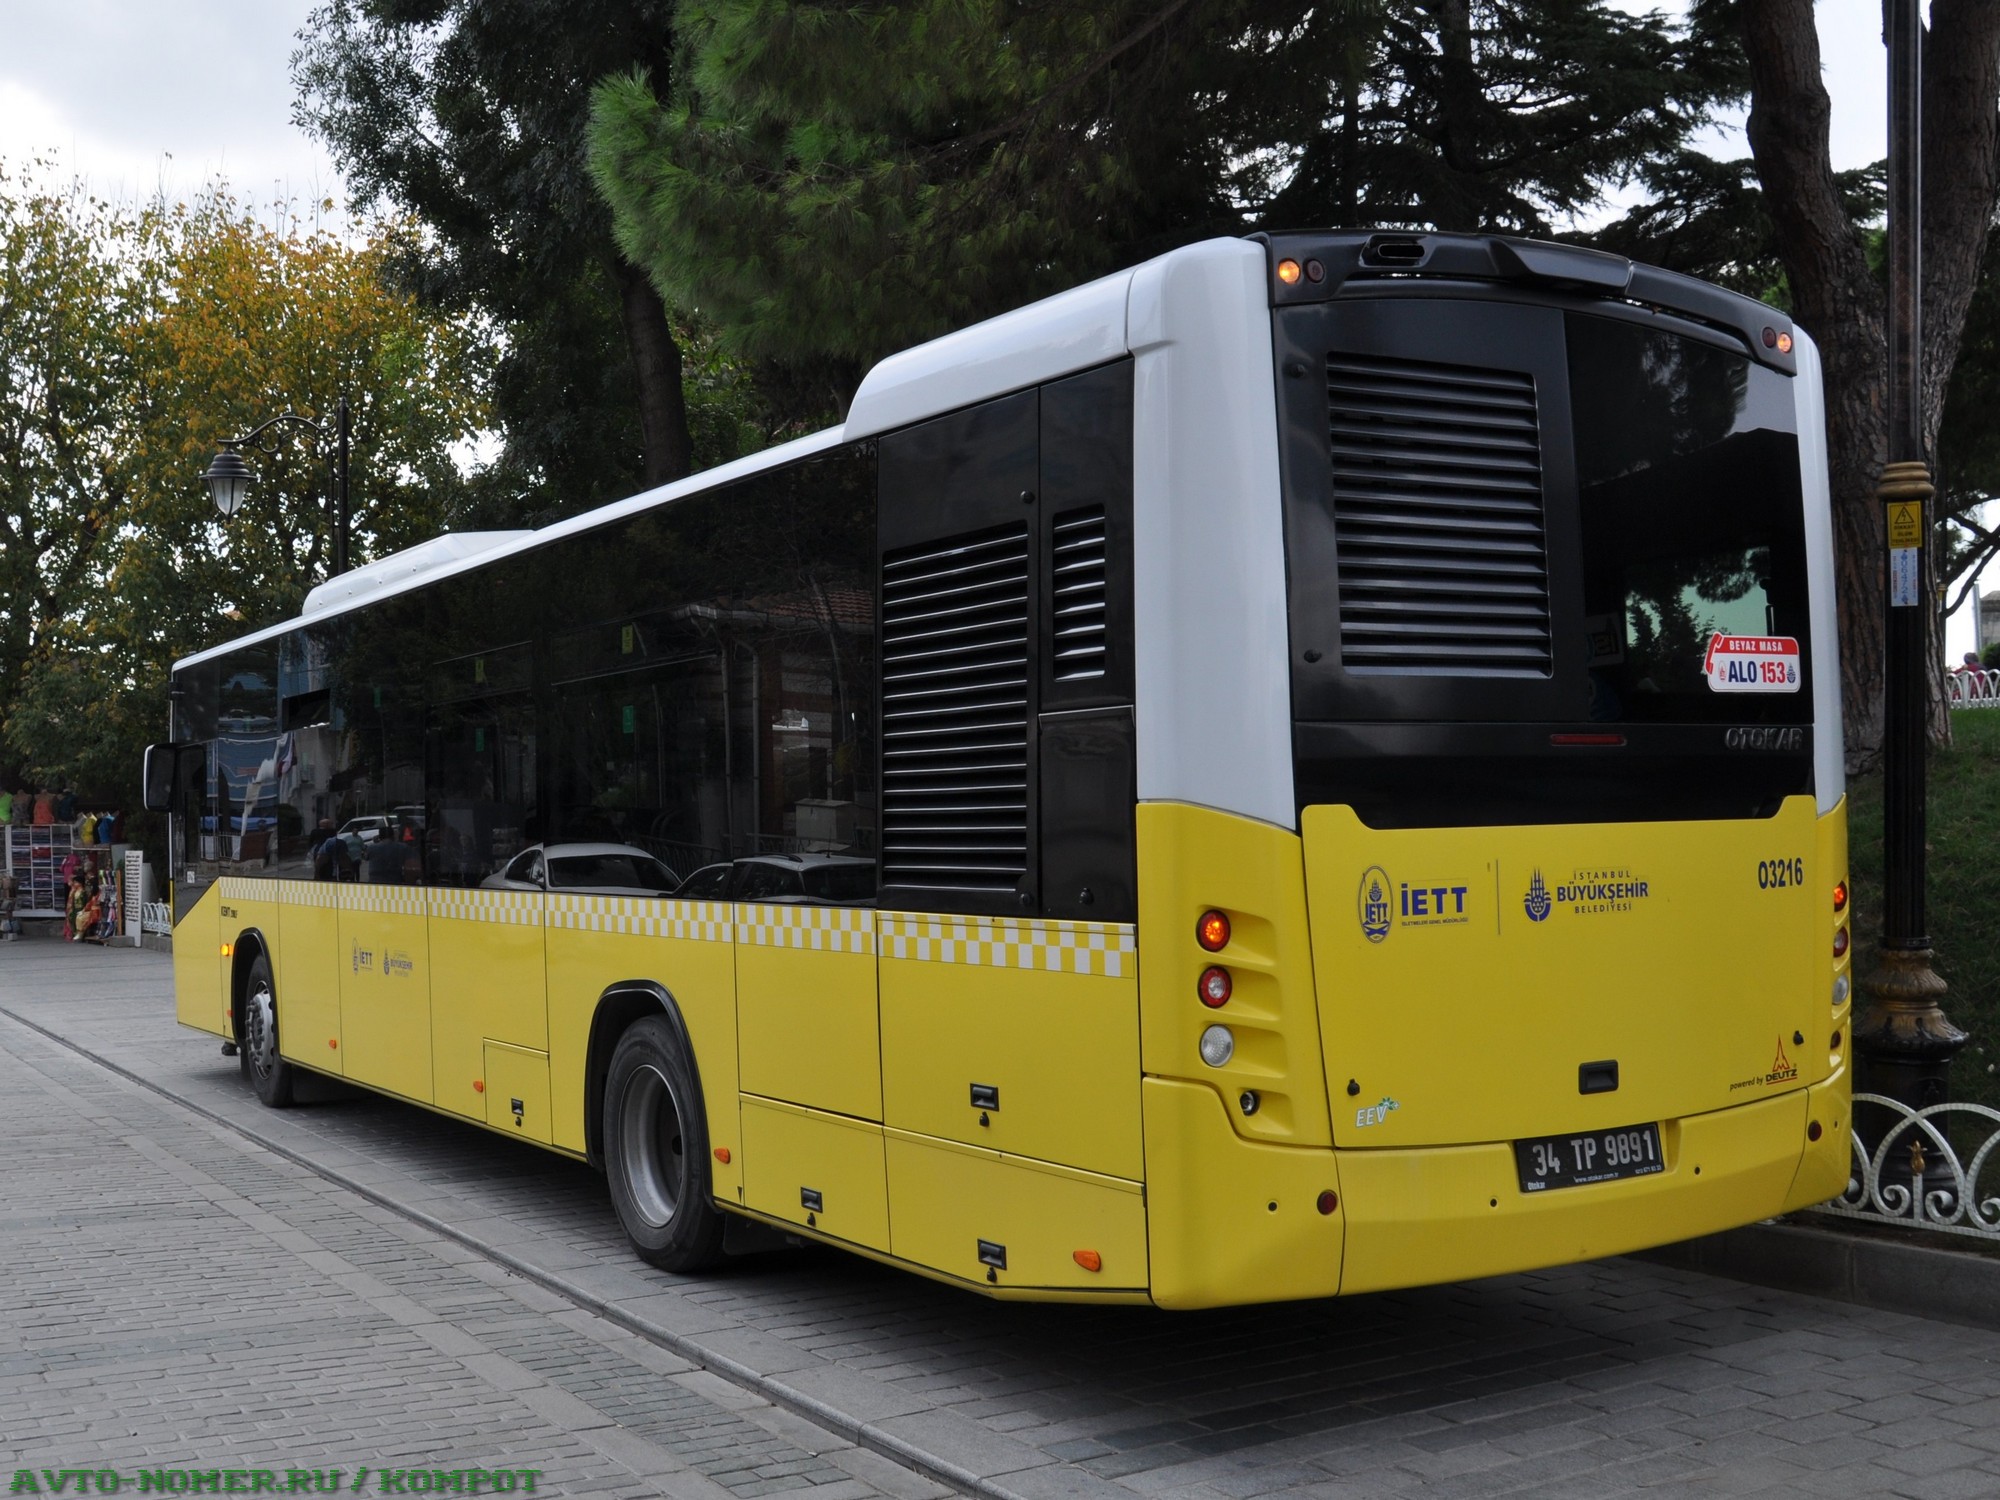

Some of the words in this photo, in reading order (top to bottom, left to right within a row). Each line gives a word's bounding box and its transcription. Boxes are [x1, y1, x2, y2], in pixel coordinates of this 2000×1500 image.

[1729, 640, 1756, 651] BEYAZ
[1760, 641, 1783, 651] MASA
[1728, 661, 1757, 683] ALO
[1760, 661, 1786, 683] 153
[1725, 727, 1803, 750] OTOKAR
[1574, 870, 1630, 881] İSTANBUL
[1758, 857, 1803, 889] 03216
[1401, 883, 1467, 916] İETT
[1557, 877, 1649, 904] BÜYÜKŞEHİR
[1575, 902, 1632, 914] BELEDİYESİ
[1730, 1077, 1755, 1091] powered
[1757, 1076, 1763, 1086] by
[1766, 1069, 1797, 1082] DEUTZ
[1356, 1106, 1388, 1127] EEV
[1532, 1143, 1561, 1176] 34
[1571, 1138, 1596, 1171] TP
[1604, 1130, 1654, 1166] 9891
